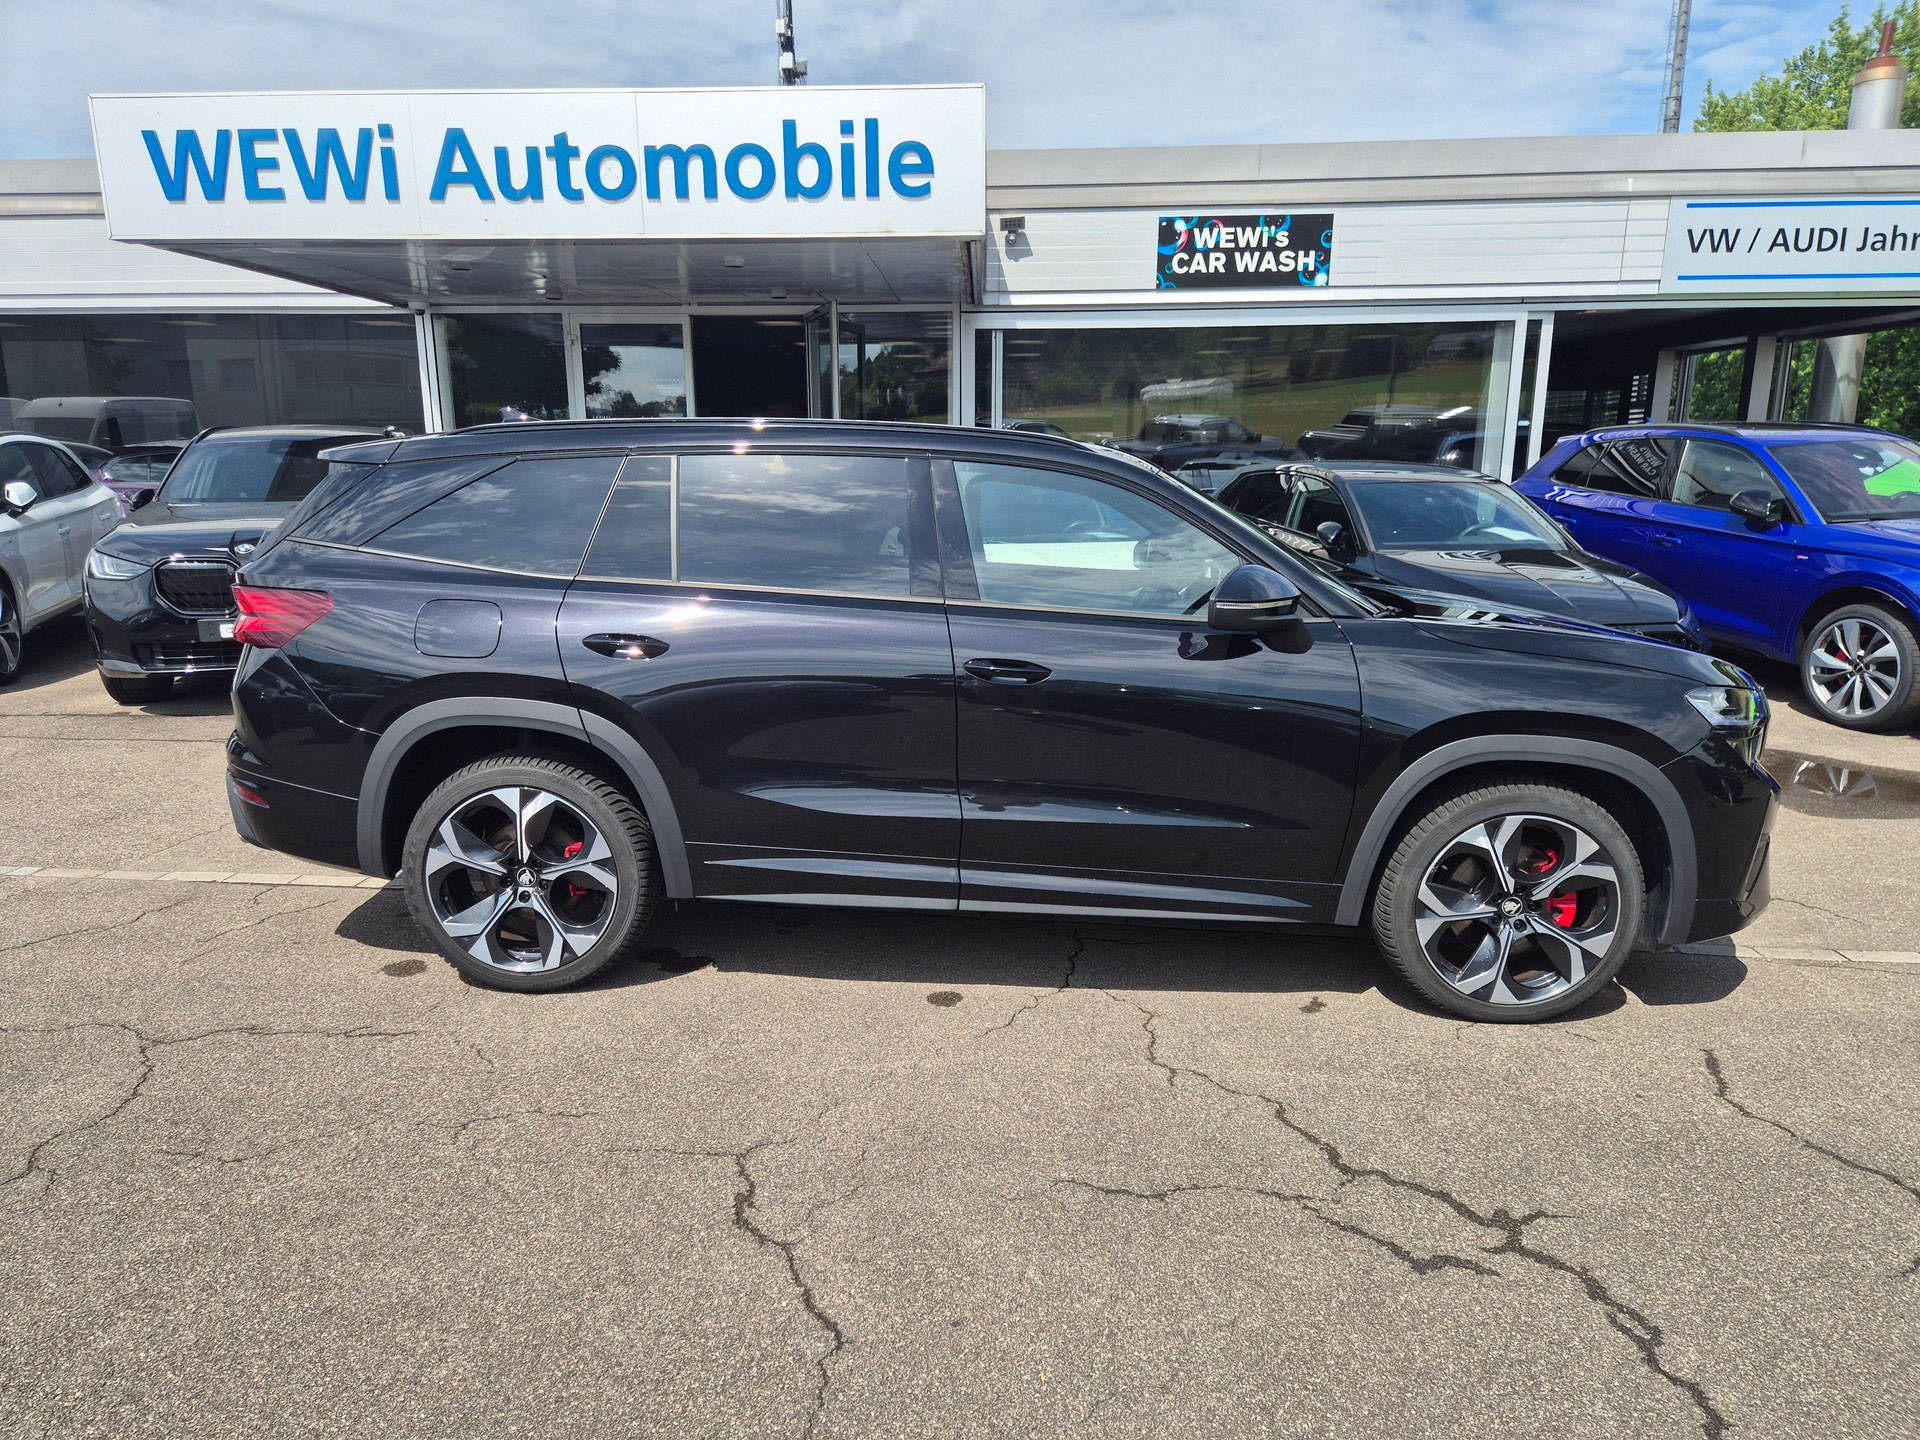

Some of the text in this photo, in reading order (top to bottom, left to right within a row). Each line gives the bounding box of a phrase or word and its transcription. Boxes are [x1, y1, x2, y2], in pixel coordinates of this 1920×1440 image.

[141, 117, 935, 202] WEWi Automobile
[1193, 225, 1290, 249] WEWi's
[1687, 228, 1741, 253] VW
[1747, 227, 1761, 253] /
[1767, 227, 1848, 253] AUDI
[1171, 250, 1316, 274] CAR WASH
